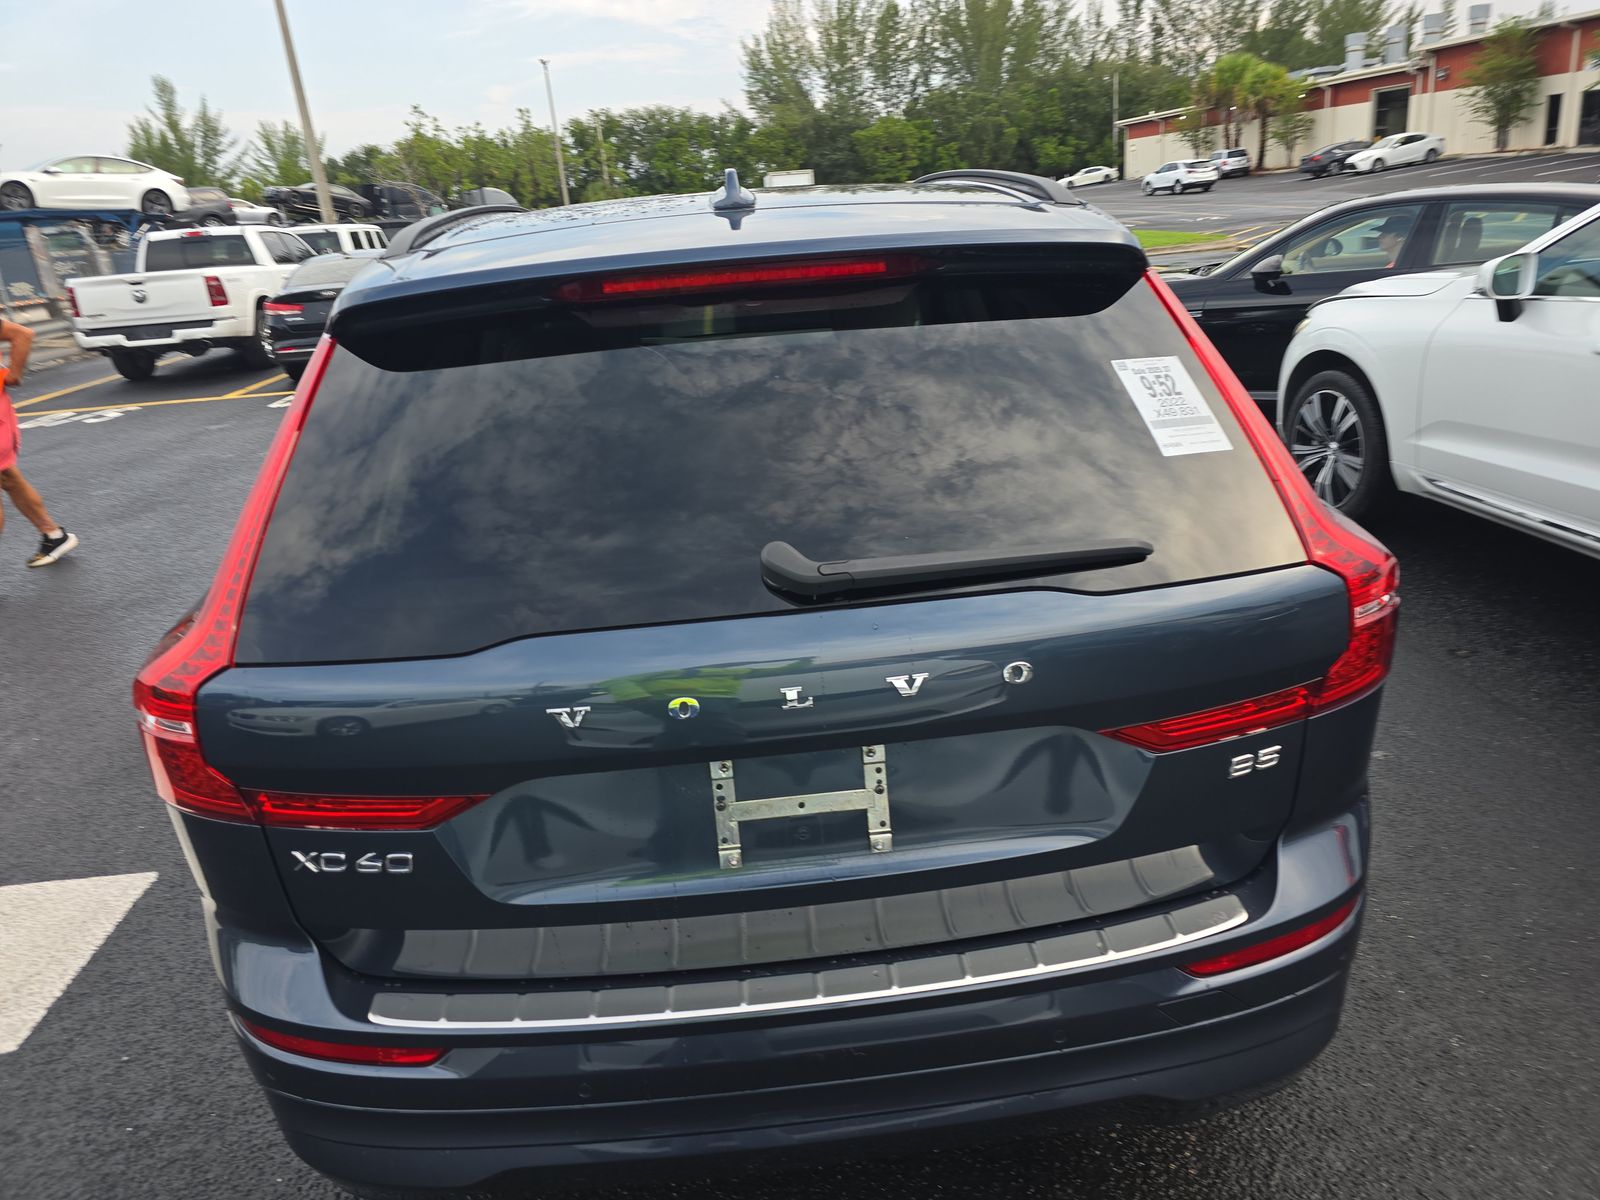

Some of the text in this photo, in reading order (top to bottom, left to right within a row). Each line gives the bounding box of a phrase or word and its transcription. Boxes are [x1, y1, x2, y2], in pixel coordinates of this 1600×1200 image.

[1140, 374, 1182, 398] 9:52
[1157, 397, 1187, 407] 2022
[546, 661, 1034, 729] VOLVO
[1227, 745, 1282, 778] B5
